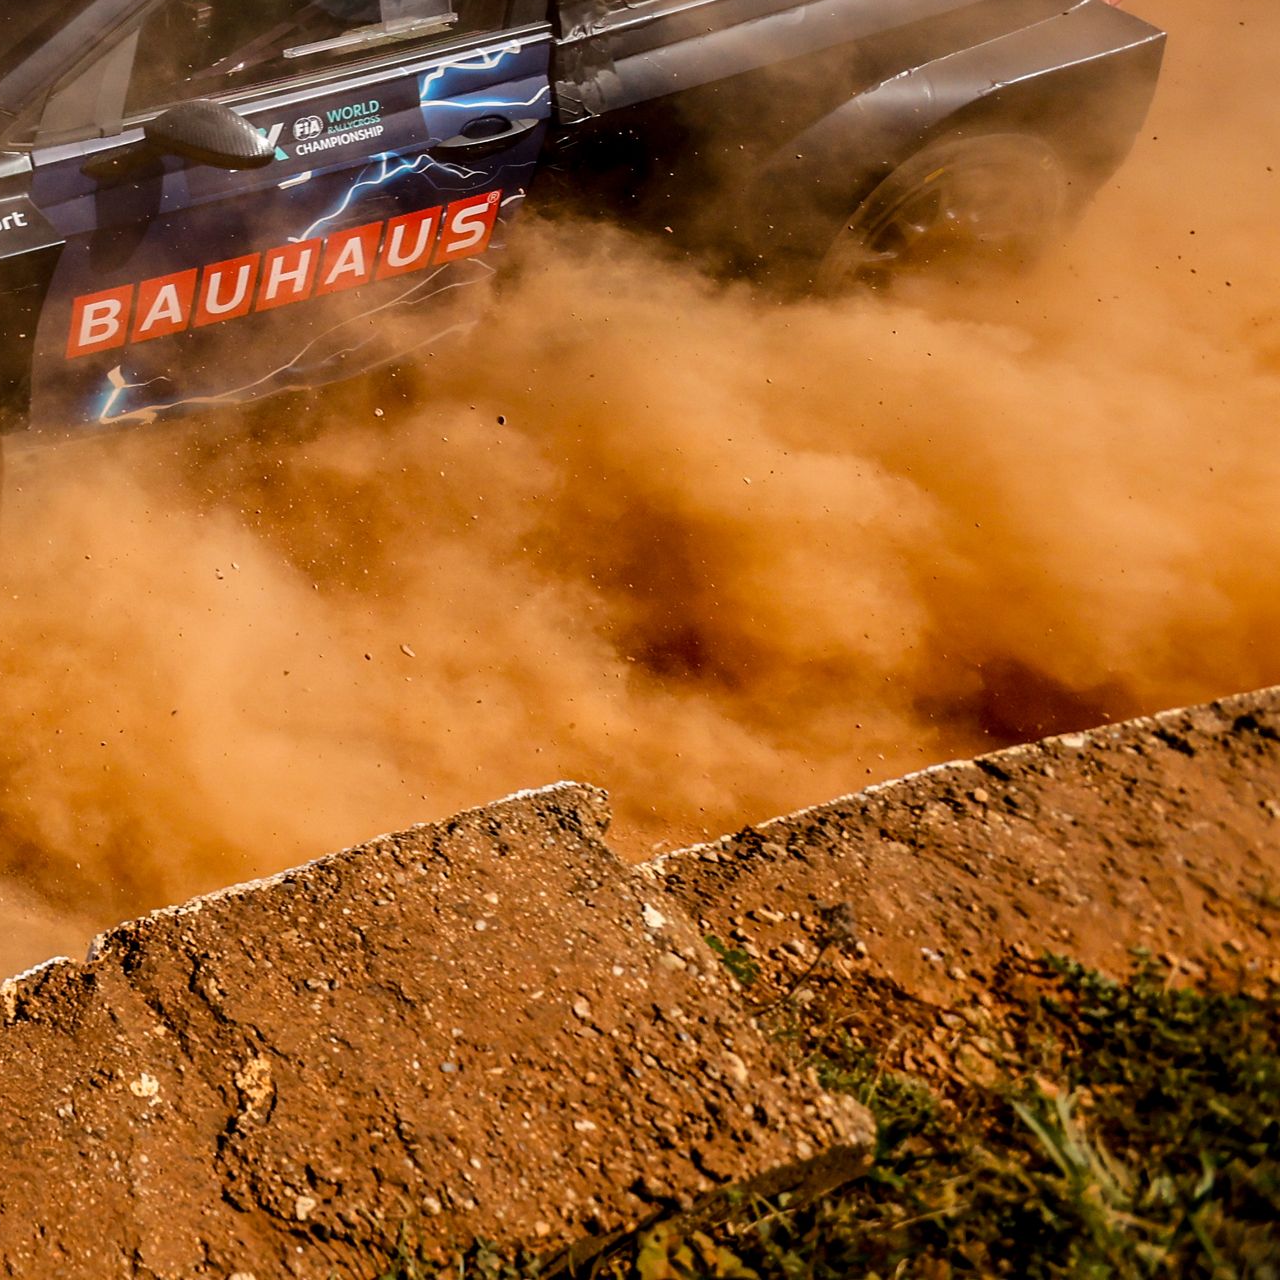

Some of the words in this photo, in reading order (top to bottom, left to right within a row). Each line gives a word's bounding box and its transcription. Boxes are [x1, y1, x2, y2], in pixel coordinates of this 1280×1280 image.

[327, 100, 380, 123] WORLD
[327, 114, 381, 134] RALLYCROSS
[296, 125, 384, 156] CHAMPIONSHIP
[77, 201, 489, 348] BAUHAUS
